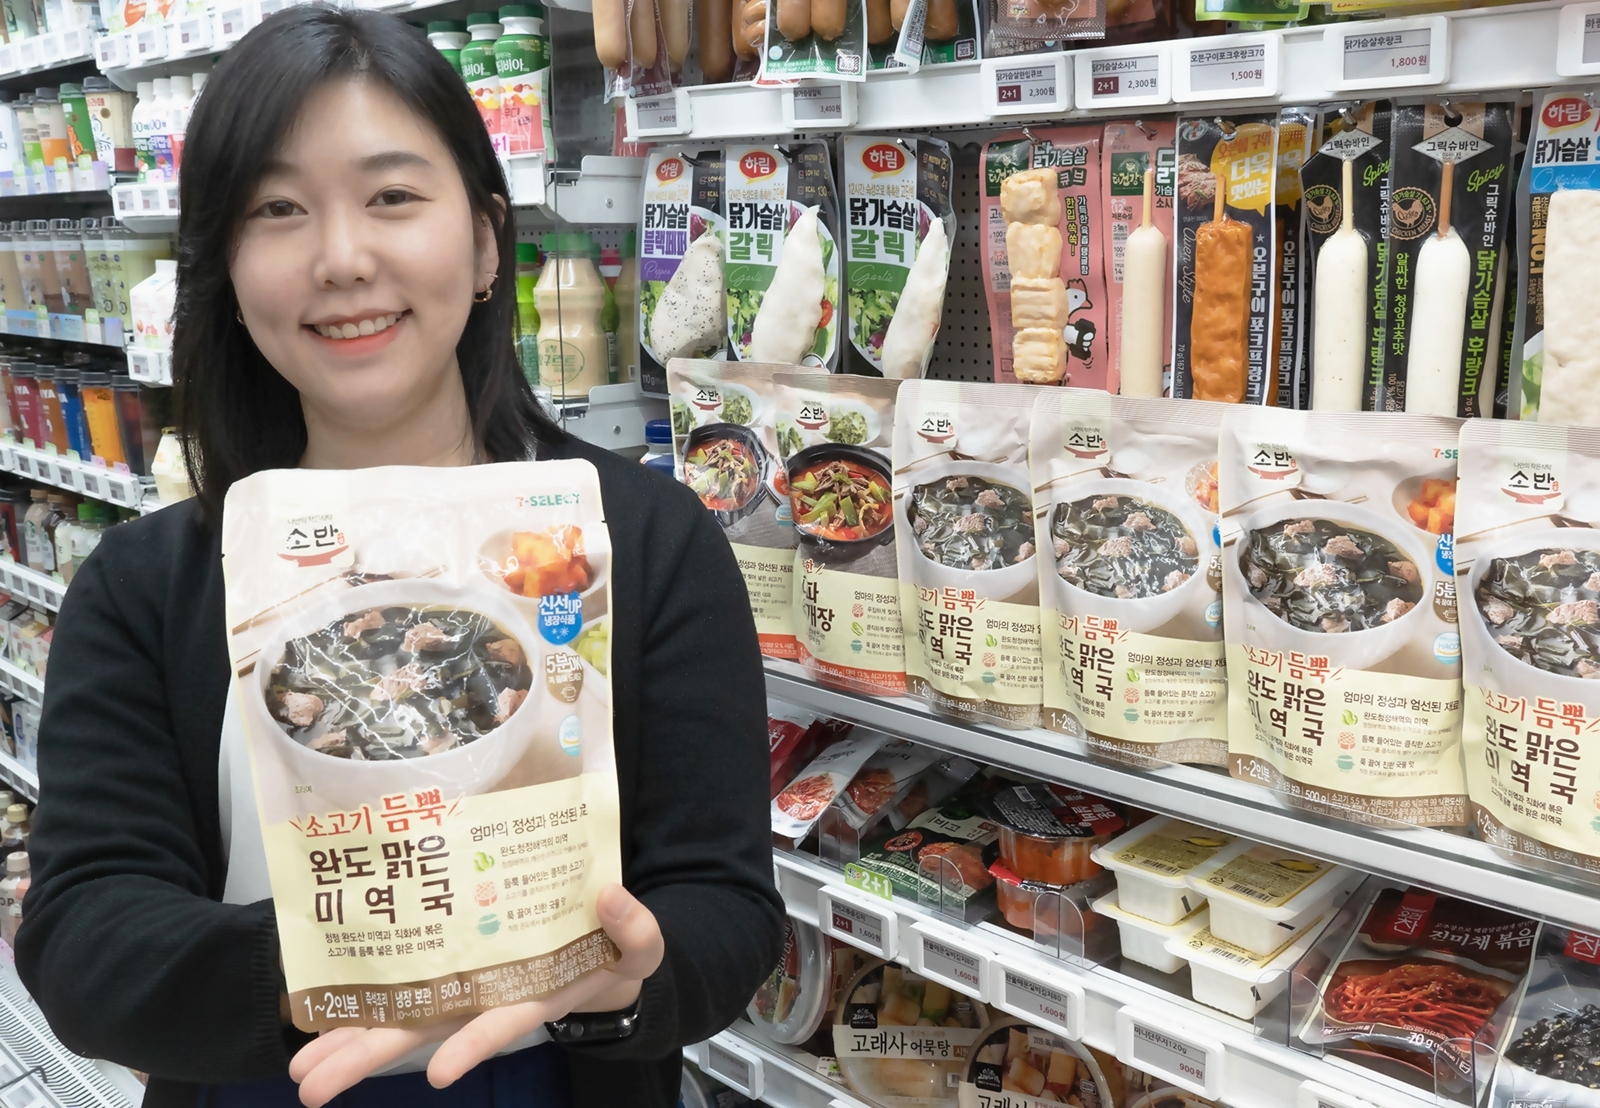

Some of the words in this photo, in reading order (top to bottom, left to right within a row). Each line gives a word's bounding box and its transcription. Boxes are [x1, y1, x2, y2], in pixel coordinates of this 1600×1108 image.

[1344, 36, 1402, 50] 닭가슴살후랑크
[1190, 48, 1265, 63] 오븐구이포크후랑크70
[1391, 56, 1427, 68] 1,800원
[996, 70, 1043, 82] 닭가슴살한입큐브
[1092, 61, 1137, 72] 닭가슴살소시지
[1231, 69, 1262, 81] 1,500원
[1029, 87, 1055, 98] 2,300원
[1097, 81, 1114, 91] 2+1
[1128, 77, 1157, 89] 2,300원
[1002, 91, 1018, 99] 2+1
[1548, 103, 1583, 122] 하림
[1325, 137, 1371, 151] 그릭슈바인
[1426, 140, 1479, 152] 그릭슈바인
[1535, 137, 1591, 164] 닭가슴살
[745, 156, 770, 174] 하림
[869, 149, 897, 169] 하림
[1033, 142, 1087, 168] 닭가슴살
[660, 161, 679, 177] 하림
[1231, 152, 1271, 180] 더욱
[1362, 159, 1391, 187] Spicy
[1058, 169, 1087, 188] 큐브
[1467, 163, 1506, 192] Spicy
[1231, 179, 1269, 201] 맛있는
[645, 203, 689, 229] 닭가슴살
[729, 202, 784, 231] 닭가슴살
[850, 197, 917, 232] 닭가슴살
[1482, 184, 1500, 247] 그릭슈바인
[1393, 226, 1417, 237] CHICKEN
[643, 230, 687, 255] 블랙페퍼
[729, 232, 773, 262] 갈릭
[851, 229, 905, 264] 갈릭
[1250, 247, 1267, 313] 오븐구이
[1282, 241, 1296, 305] 오븐구이
[1394, 252, 1409, 290] 알싸한
[1470, 249, 1497, 330] 닭가슴살
[1392, 293, 1407, 356] 청양고추맛
[1462, 336, 1486, 396] 후랑크
[696, 389, 719, 402] 소반
[799, 406, 825, 420] 소반
[921, 418, 951, 433] 소반
[1069, 433, 1103, 448] 소반
[1253, 450, 1292, 467] 소반
[1508, 470, 1555, 490] 소반
[286, 524, 339, 549] 소반
[757, 562, 778, 573] 엄선된
[538, 593, 582, 616] 신선UP
[854, 590, 874, 602] 엄마의
[875, 594, 897, 604] 정성과
[942, 588, 977, 613] 듬뿍
[939, 613, 974, 640] 맑은
[986, 618, 1010, 631] 엄마의
[1011, 621, 1036, 634] 정성과
[1083, 615, 1118, 645] 듬뿍
[1080, 643, 1115, 675] 맑은
[1128, 651, 1153, 665] 엄마의
[1156, 655, 1182, 667] 정성과
[1185, 657, 1212, 669] 엄선된
[1247, 646, 1284, 673] 소고기
[1288, 651, 1331, 684] 듬뿍
[1247, 669, 1276, 701] 완도
[1282, 682, 1326, 712] 맑은
[1344, 691, 1375, 706] 엄마의
[1377, 696, 1407, 709] 정성과
[1410, 699, 1441, 713] 엄선된
[1444, 700, 1460, 711] 재료
[1485, 690, 1526, 721] 소고기
[1532, 698, 1586, 735] 듬뿍
[1376, 736, 1402, 748] 들어있는
[1425, 740, 1443, 748] 소고기
[1486, 715, 1518, 752] 완도
[1526, 731, 1581, 765] 맑은
[1382, 759, 1394, 769] 진한
[1236, 757, 1270, 783] 1~2인분
[1305, 788, 1320, 800] 500
[306, 806, 373, 838] 소고기
[381, 789, 447, 833] 듬뿍
[1540, 811, 1562, 826] 미역국
[1548, 803, 1563, 816] 볶은
[470, 821, 509, 842] 엄마의
[512, 814, 547, 835] 정성과
[549, 807, 578, 827] 엄선된
[309, 846, 376, 886] 완도
[382, 836, 450, 880] 맑은
[862, 871, 890, 897] 2+1
[325, 933, 341, 944] 청정
[341, 930, 366, 943] 완도산
[368, 929, 392, 941] 미역과
[394, 927, 422, 940] 직화에
[424, 923, 443, 936] 볶은
[835, 917, 850, 930] 2+1
[1394, 917, 1418, 935] 찬
[859, 927, 881, 943] 1,600원
[1429, 930, 1492, 951] 진미채
[1495, 927, 1535, 950] 볶음
[328, 948, 357, 959] 소고기를
[417, 938, 444, 951] 미역국
[954, 968, 979, 984] 1,600원
[304, 992, 360, 1021] 1~2인분
[395, 990, 412, 1008] 냉장
[415, 987, 432, 1005] 보관
[441, 980, 461, 999] 500
[1038, 1003, 1066, 1020] 1,600원
[850, 1031, 908, 1056] 고래사
[910, 1038, 951, 1058] 어묵탕
[1134, 1026, 1187, 1055] 미니단무지120g
[1179, 1062, 1203, 1080] 900원
